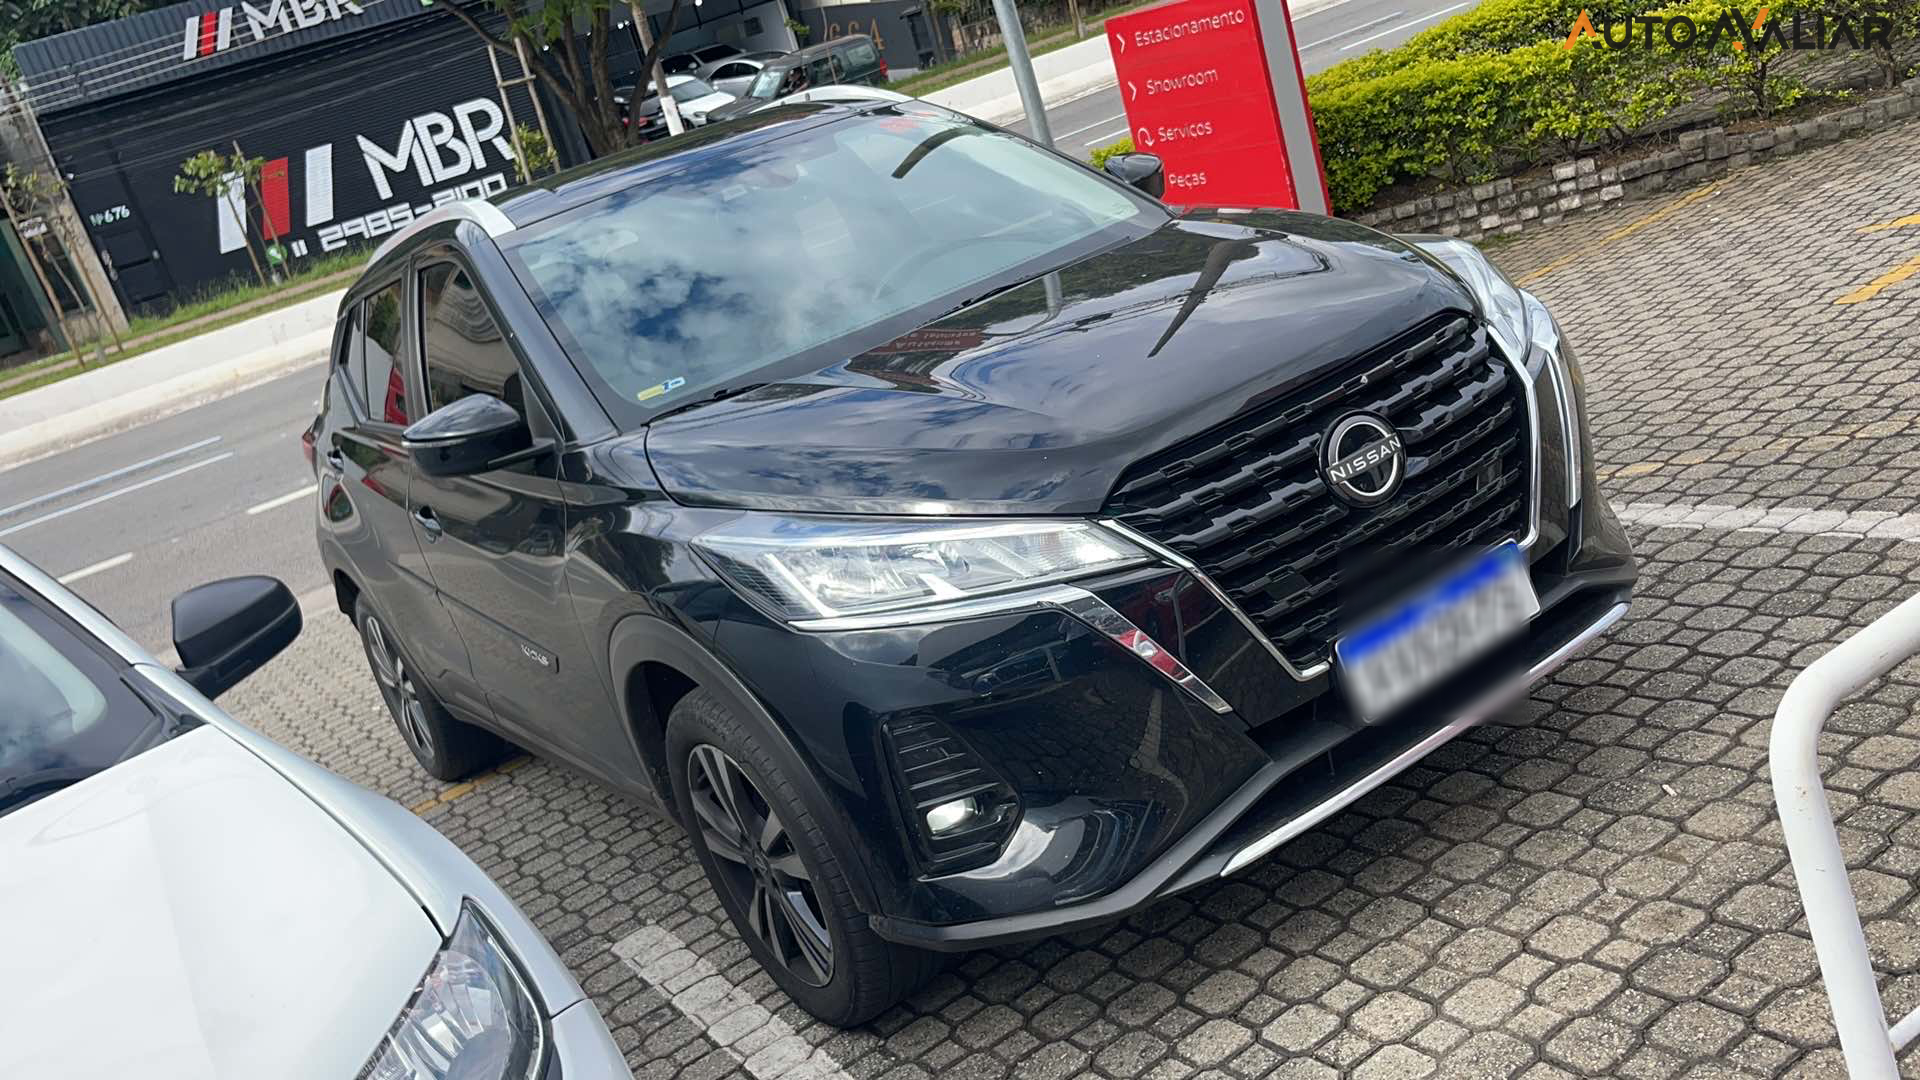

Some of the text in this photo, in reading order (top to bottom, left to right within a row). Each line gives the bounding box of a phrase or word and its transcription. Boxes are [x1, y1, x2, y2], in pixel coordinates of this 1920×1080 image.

[1134, 9, 1245, 47] Estacionamento
[1146, 69, 1218, 95] Showroom
[355, 97, 516, 200] MBR
[1168, 172, 1207, 189] Peças
[1330, 436, 1401, 481] NISSAN
